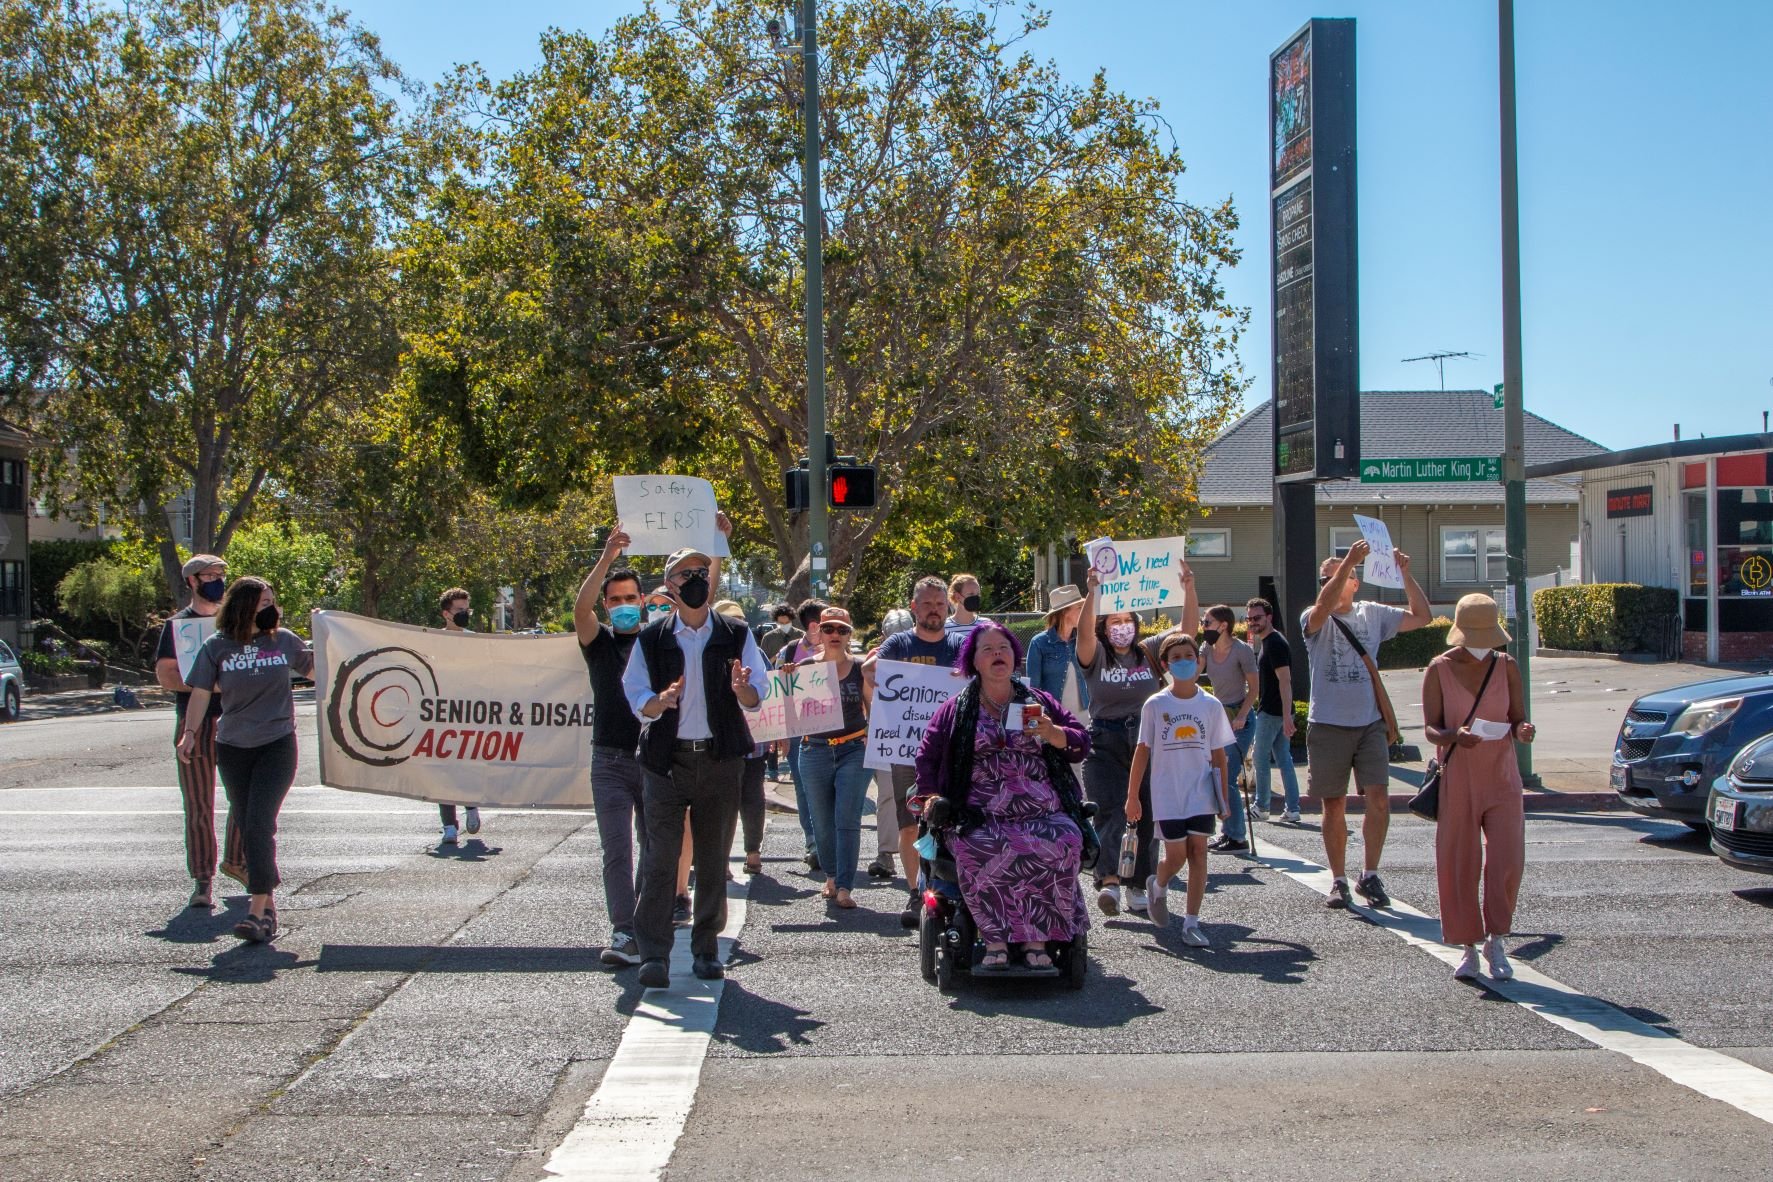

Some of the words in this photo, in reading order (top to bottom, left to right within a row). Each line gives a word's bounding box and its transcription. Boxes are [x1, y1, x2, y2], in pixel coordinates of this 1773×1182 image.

[1292, 223, 1308, 242] CHECK
[1382, 461, 1412, 478] Martin
[1416, 461, 1446, 477] Luther
[1451, 460, 1471, 480] King
[1475, 460, 1486, 476] Jr
[645, 508, 706, 530] FIRST
[1118, 552, 1141, 576] We
[1146, 552, 1170, 569] need
[1101, 581, 1130, 596] more
[1139, 575, 1161, 592] time
[1114, 595, 1125, 611] to
[231, 652, 258, 662] Your
[243, 645, 259, 654] Be
[222, 653, 288, 672] Normal
[809, 671, 828, 688] for
[1100, 667, 1153, 683] Normal
[878, 674, 949, 703] Seniors
[419, 698, 503, 725] SENIOR
[509, 702, 524, 726] &
[875, 725, 901, 739] need
[1161, 725, 1171, 741] CAL
[1168, 713, 1192, 727] YOUTH
[1193, 716, 1206, 740] CAMPS
[411, 728, 524, 762] ACTION
[877, 742, 893, 758] to
